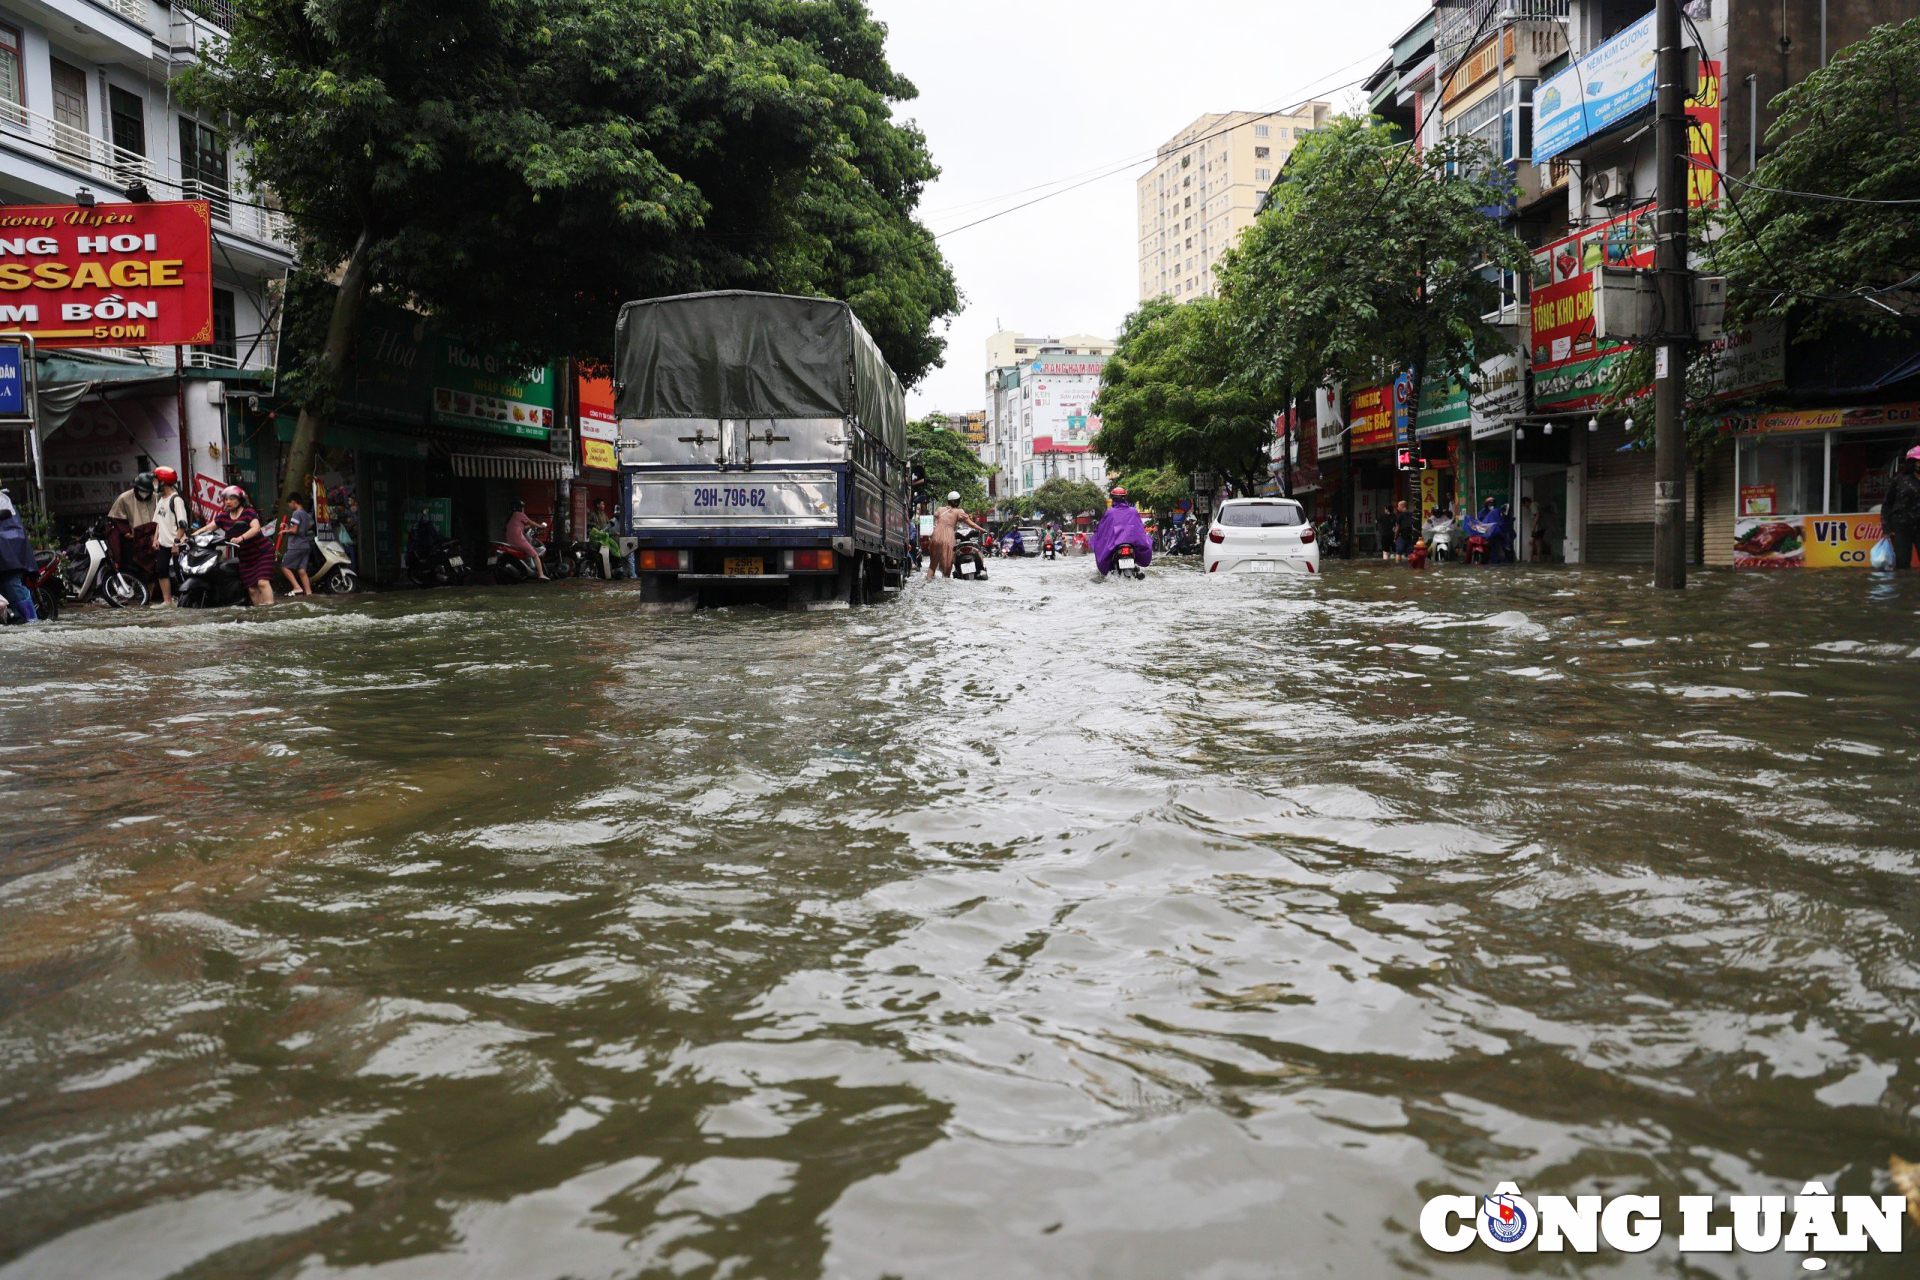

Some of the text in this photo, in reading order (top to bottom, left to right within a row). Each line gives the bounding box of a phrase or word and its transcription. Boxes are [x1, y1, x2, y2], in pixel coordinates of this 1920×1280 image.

[1604, 43, 1619, 61] KIM
[63, 211, 134, 227] Uyên
[77, 234, 157, 253] HOI
[0, 260, 184, 290] SSAGE
[61, 293, 158, 321] BỒN
[1534, 294, 1556, 333] TỔNG
[1556, 295, 1575, 326] KHO
[94, 325, 146, 338] 50M
[1374, 405, 1393, 431] BẮC
[1805, 411, 1840, 426] Anh
[1814, 521, 1848, 547] Vịt
[735, 557, 753, 568] 29H
